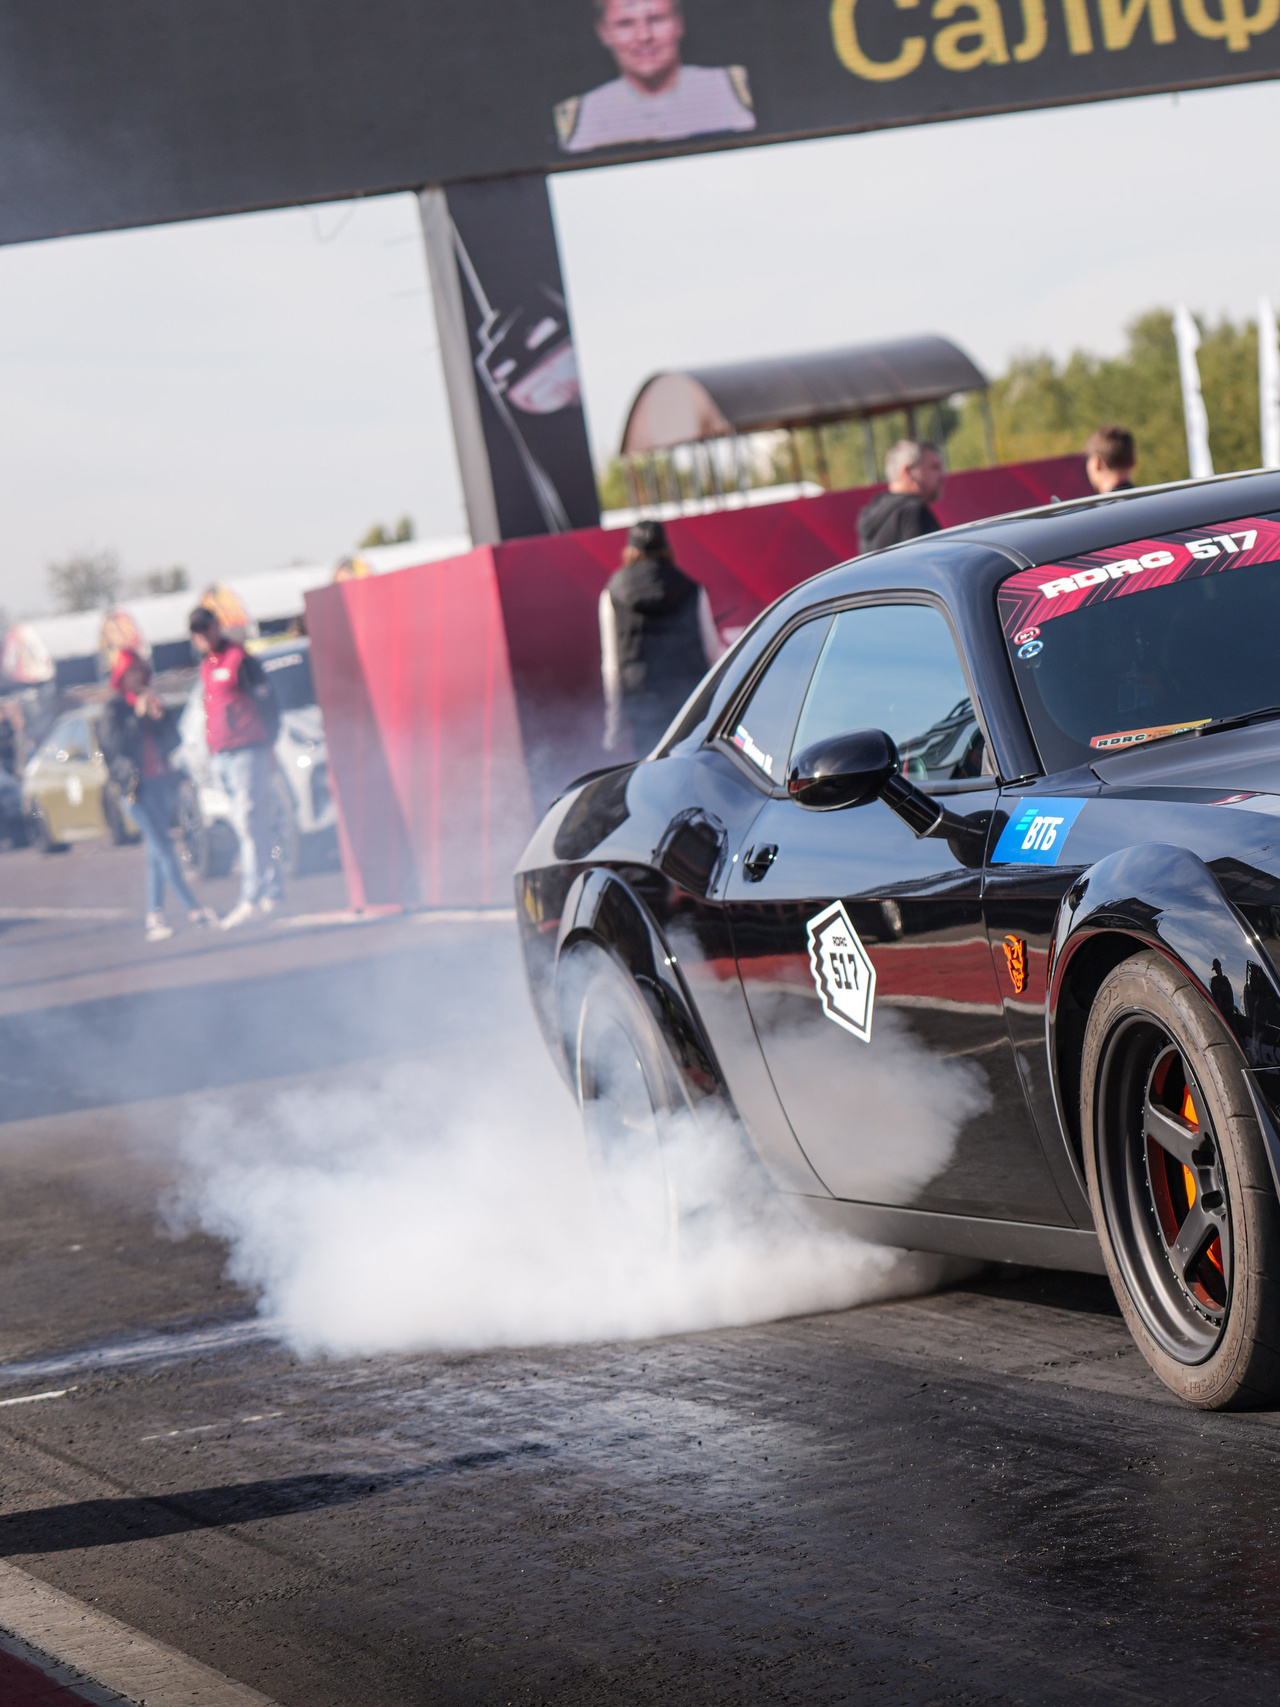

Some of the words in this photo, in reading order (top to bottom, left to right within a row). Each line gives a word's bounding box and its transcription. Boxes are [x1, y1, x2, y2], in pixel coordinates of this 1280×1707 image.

[1037, 550, 1175, 599] RDRC
[1185, 529, 1258, 559] 517
[1096, 733, 1146, 748] RDRC
[1021, 816, 1065, 851] ВТБ
[829, 952, 860, 990] 517
